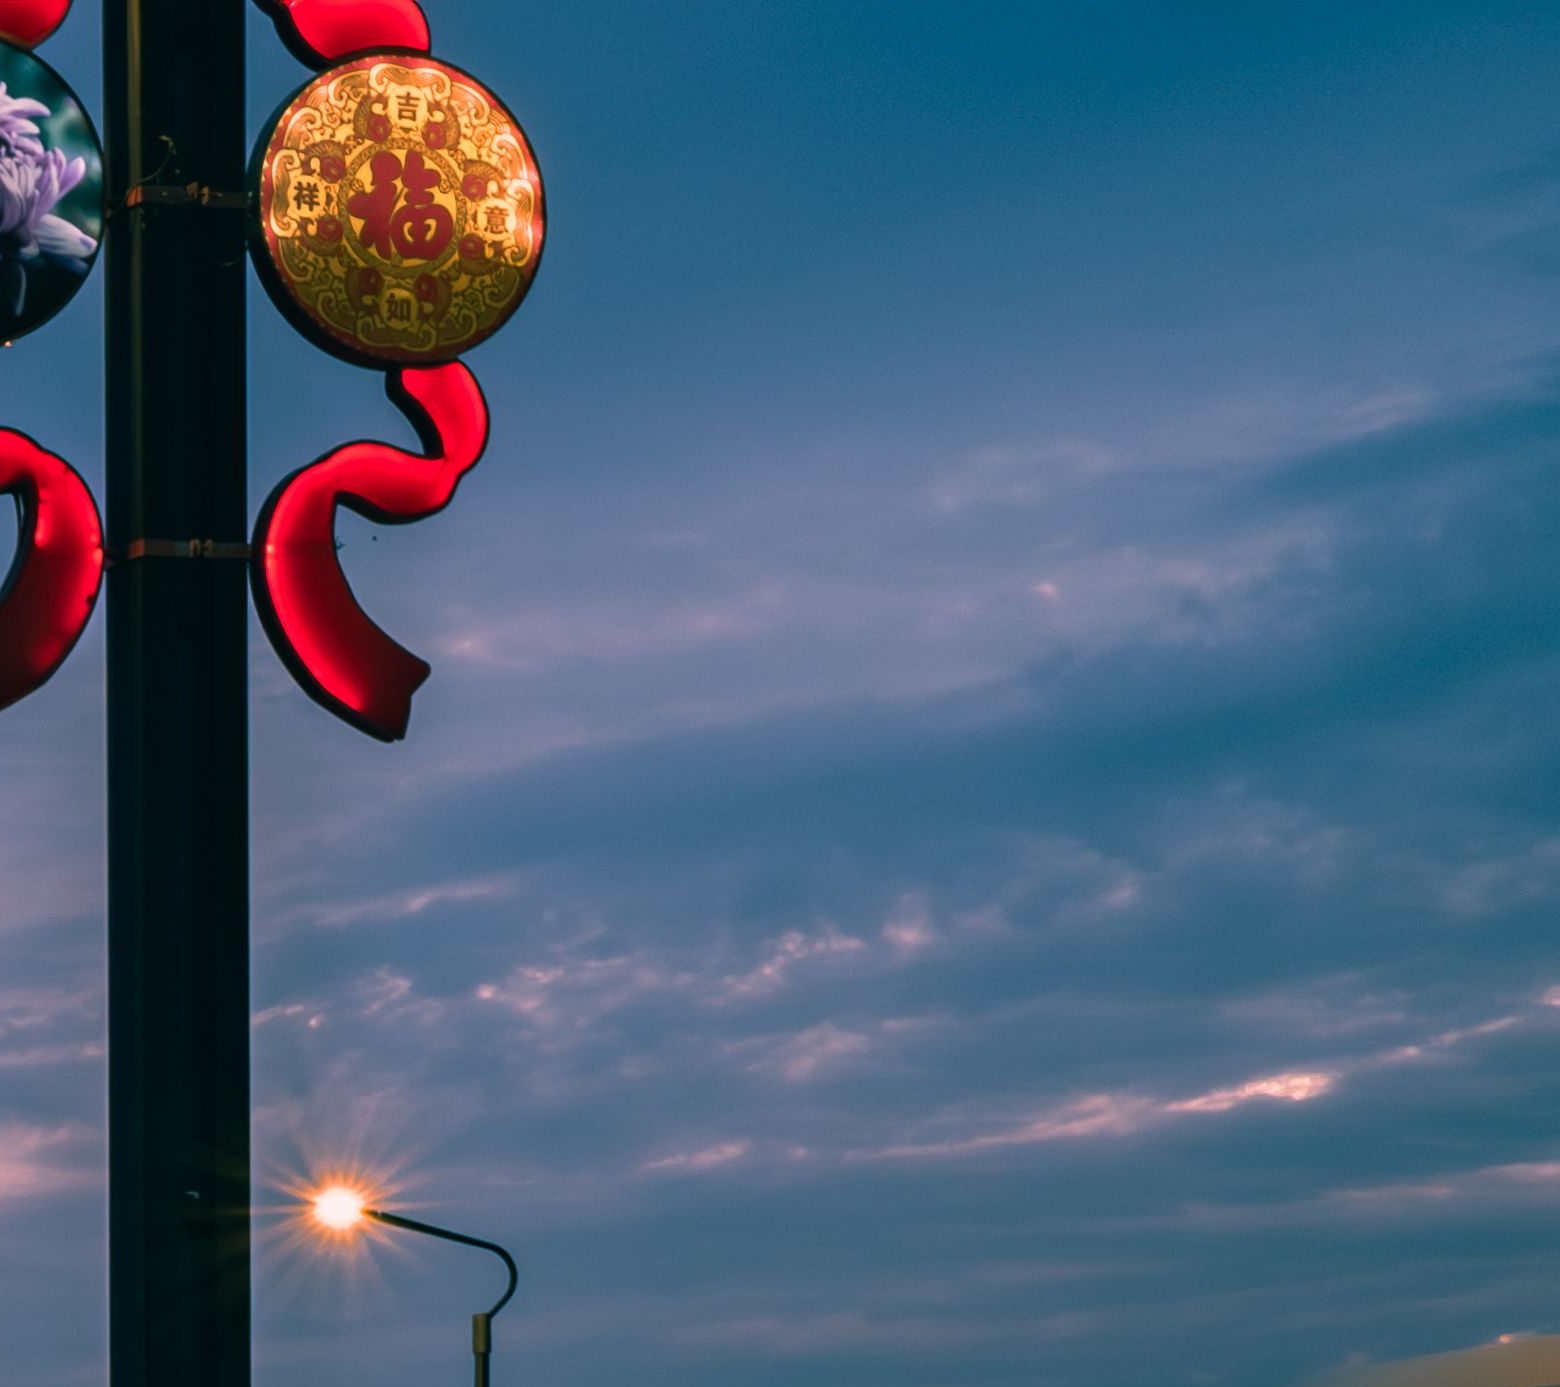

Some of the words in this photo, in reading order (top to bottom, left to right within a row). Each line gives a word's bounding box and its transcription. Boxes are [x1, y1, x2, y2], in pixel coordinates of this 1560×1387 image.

[396, 92, 420, 122] 吉
[293, 180, 320, 211] 祥
[346, 150, 454, 260] 福
[483, 206, 509, 234] 意
[387, 293, 411, 322] 如
